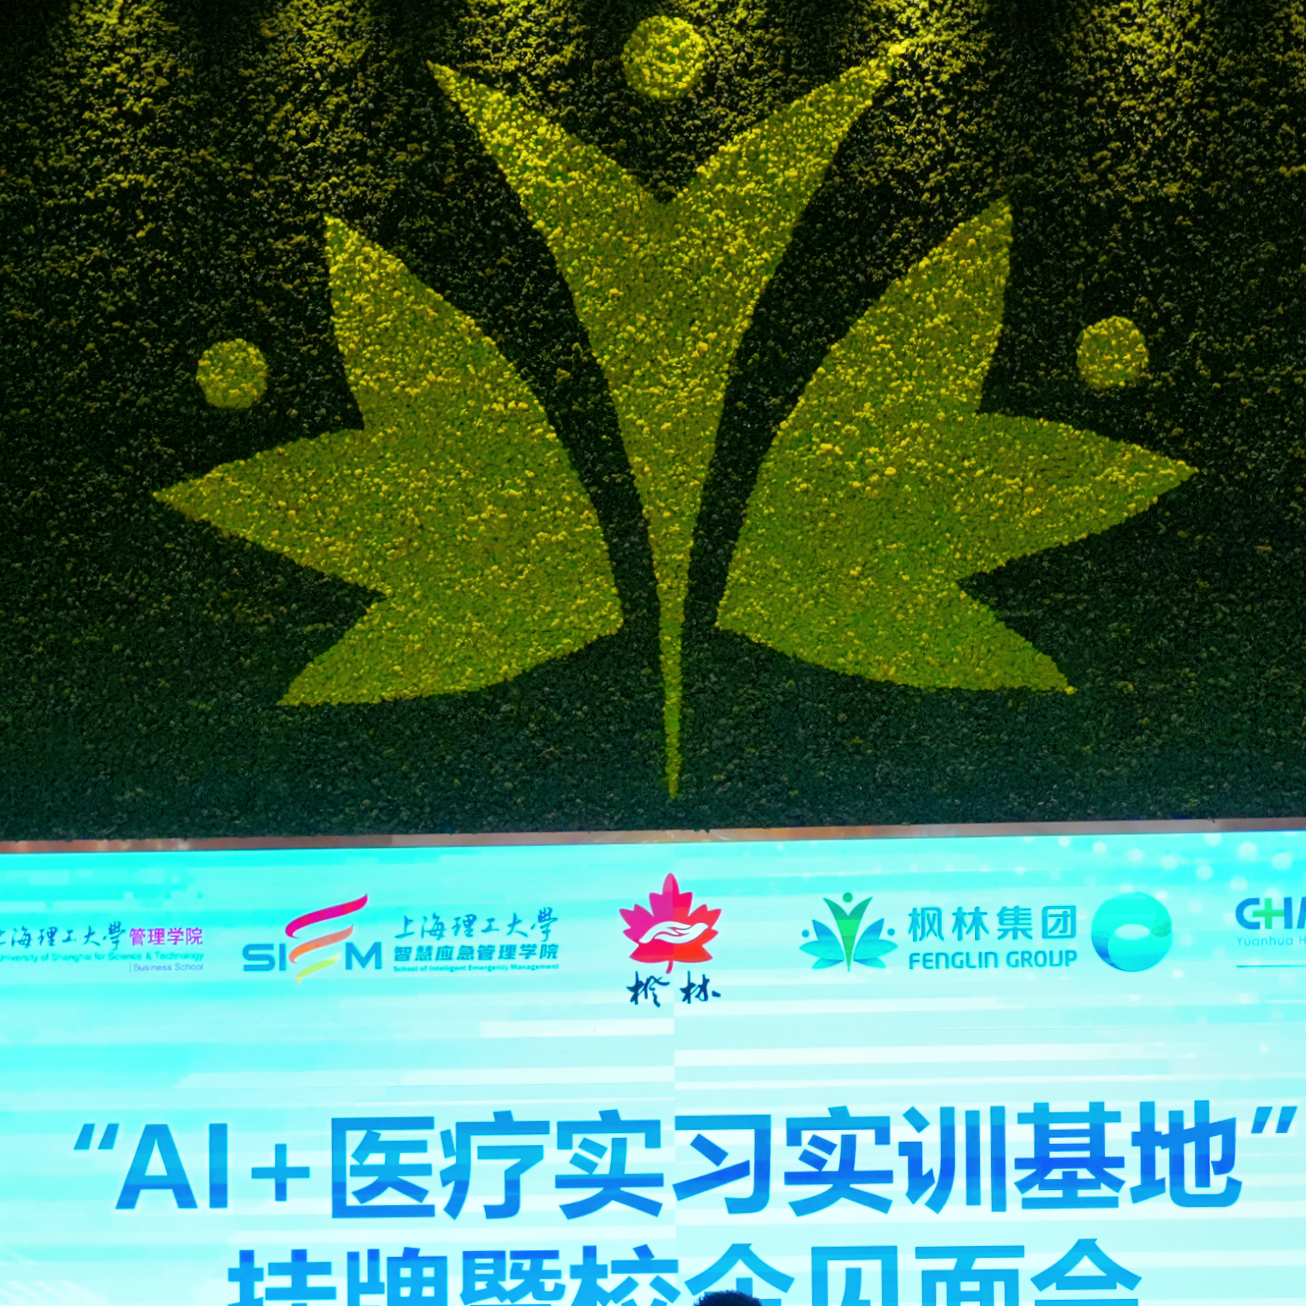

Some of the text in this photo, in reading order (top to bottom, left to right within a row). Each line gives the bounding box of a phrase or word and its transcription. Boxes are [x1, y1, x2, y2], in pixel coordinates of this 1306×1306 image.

[908, 905, 1078, 942] 枫林集团
[128, 927, 204, 946] 管理学院
[1236, 935, 1293, 947] Yuanhua
[51, 952, 92, 963] Shanghai
[108, 952, 143, 961] Science
[154, 951, 205, 962] Technology
[394, 944, 559, 961] 智慧应急管理学院
[909, 949, 1078, 970] FENGLIN GROUP
[133, 962, 204, 972] Business School
